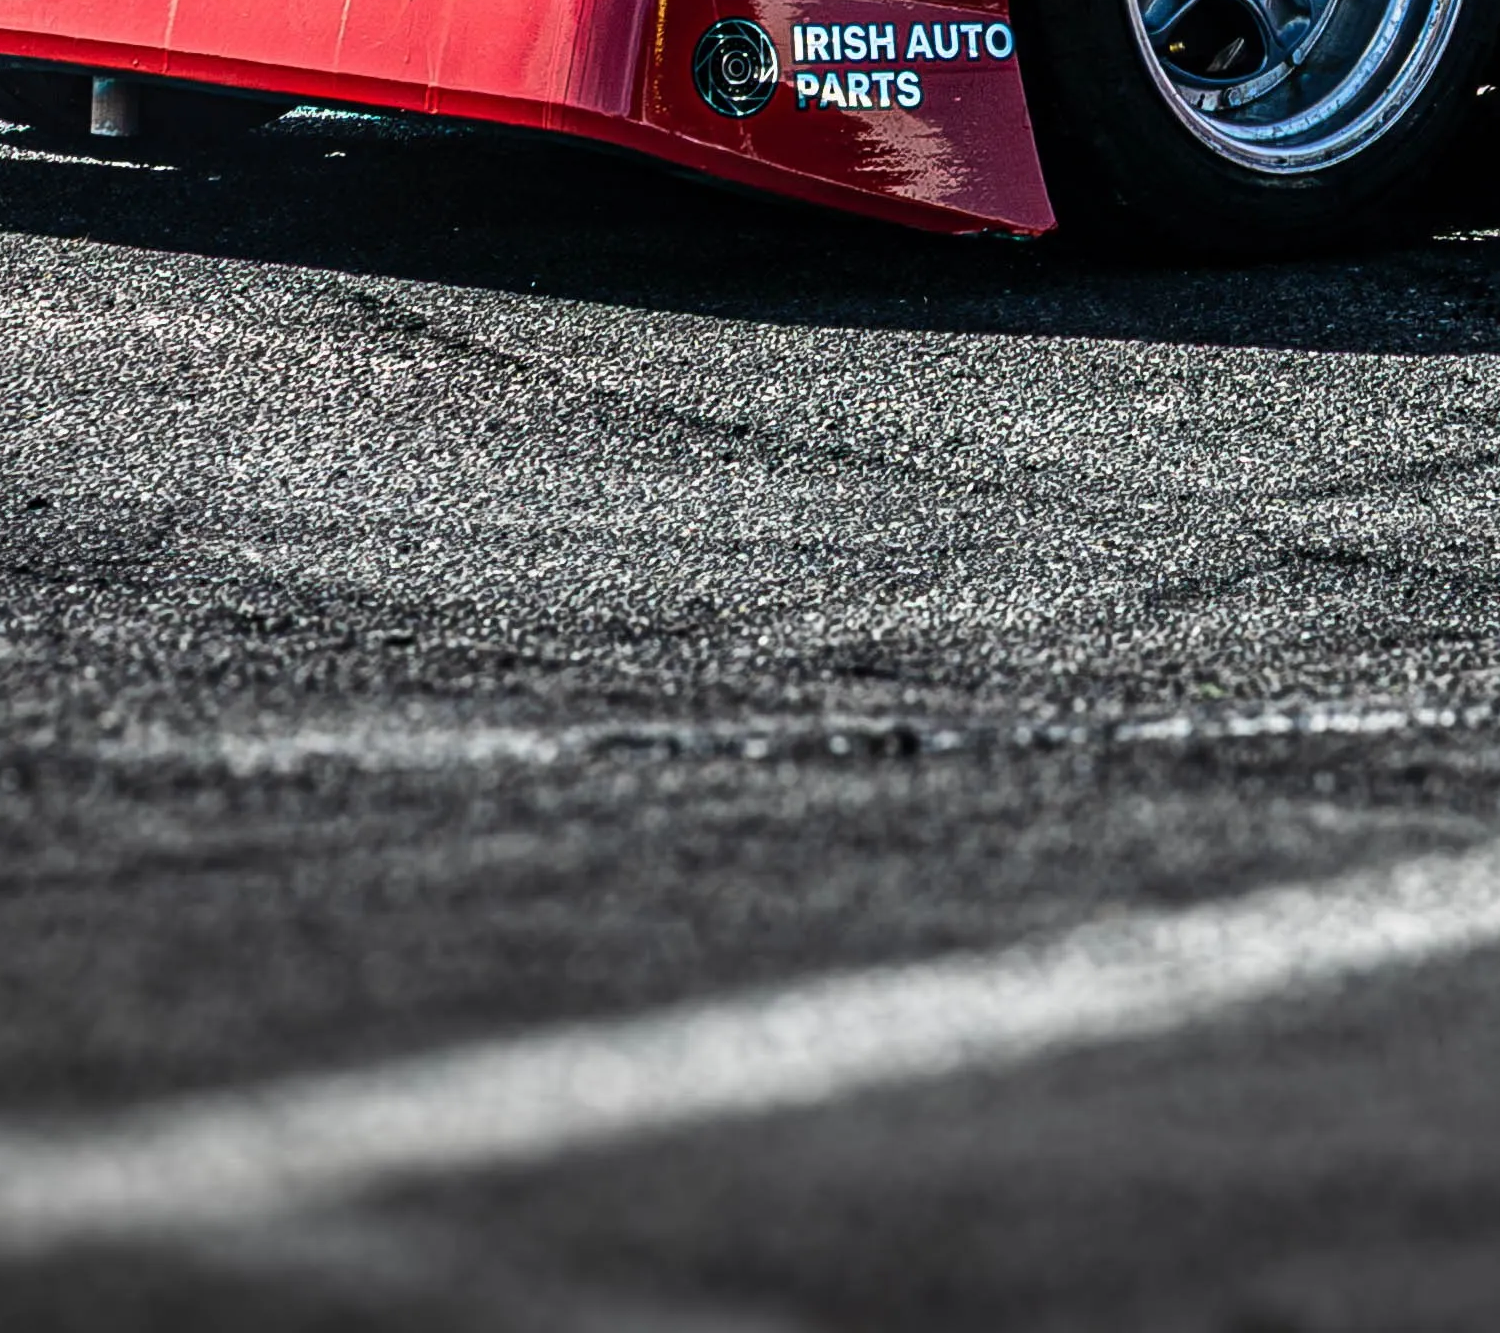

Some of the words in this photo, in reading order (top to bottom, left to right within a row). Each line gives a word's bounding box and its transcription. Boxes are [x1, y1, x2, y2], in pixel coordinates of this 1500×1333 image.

[793, 23, 897, 62] IRISH
[907, 23, 1015, 60] AUTO
[797, 71, 923, 109] PARTS
